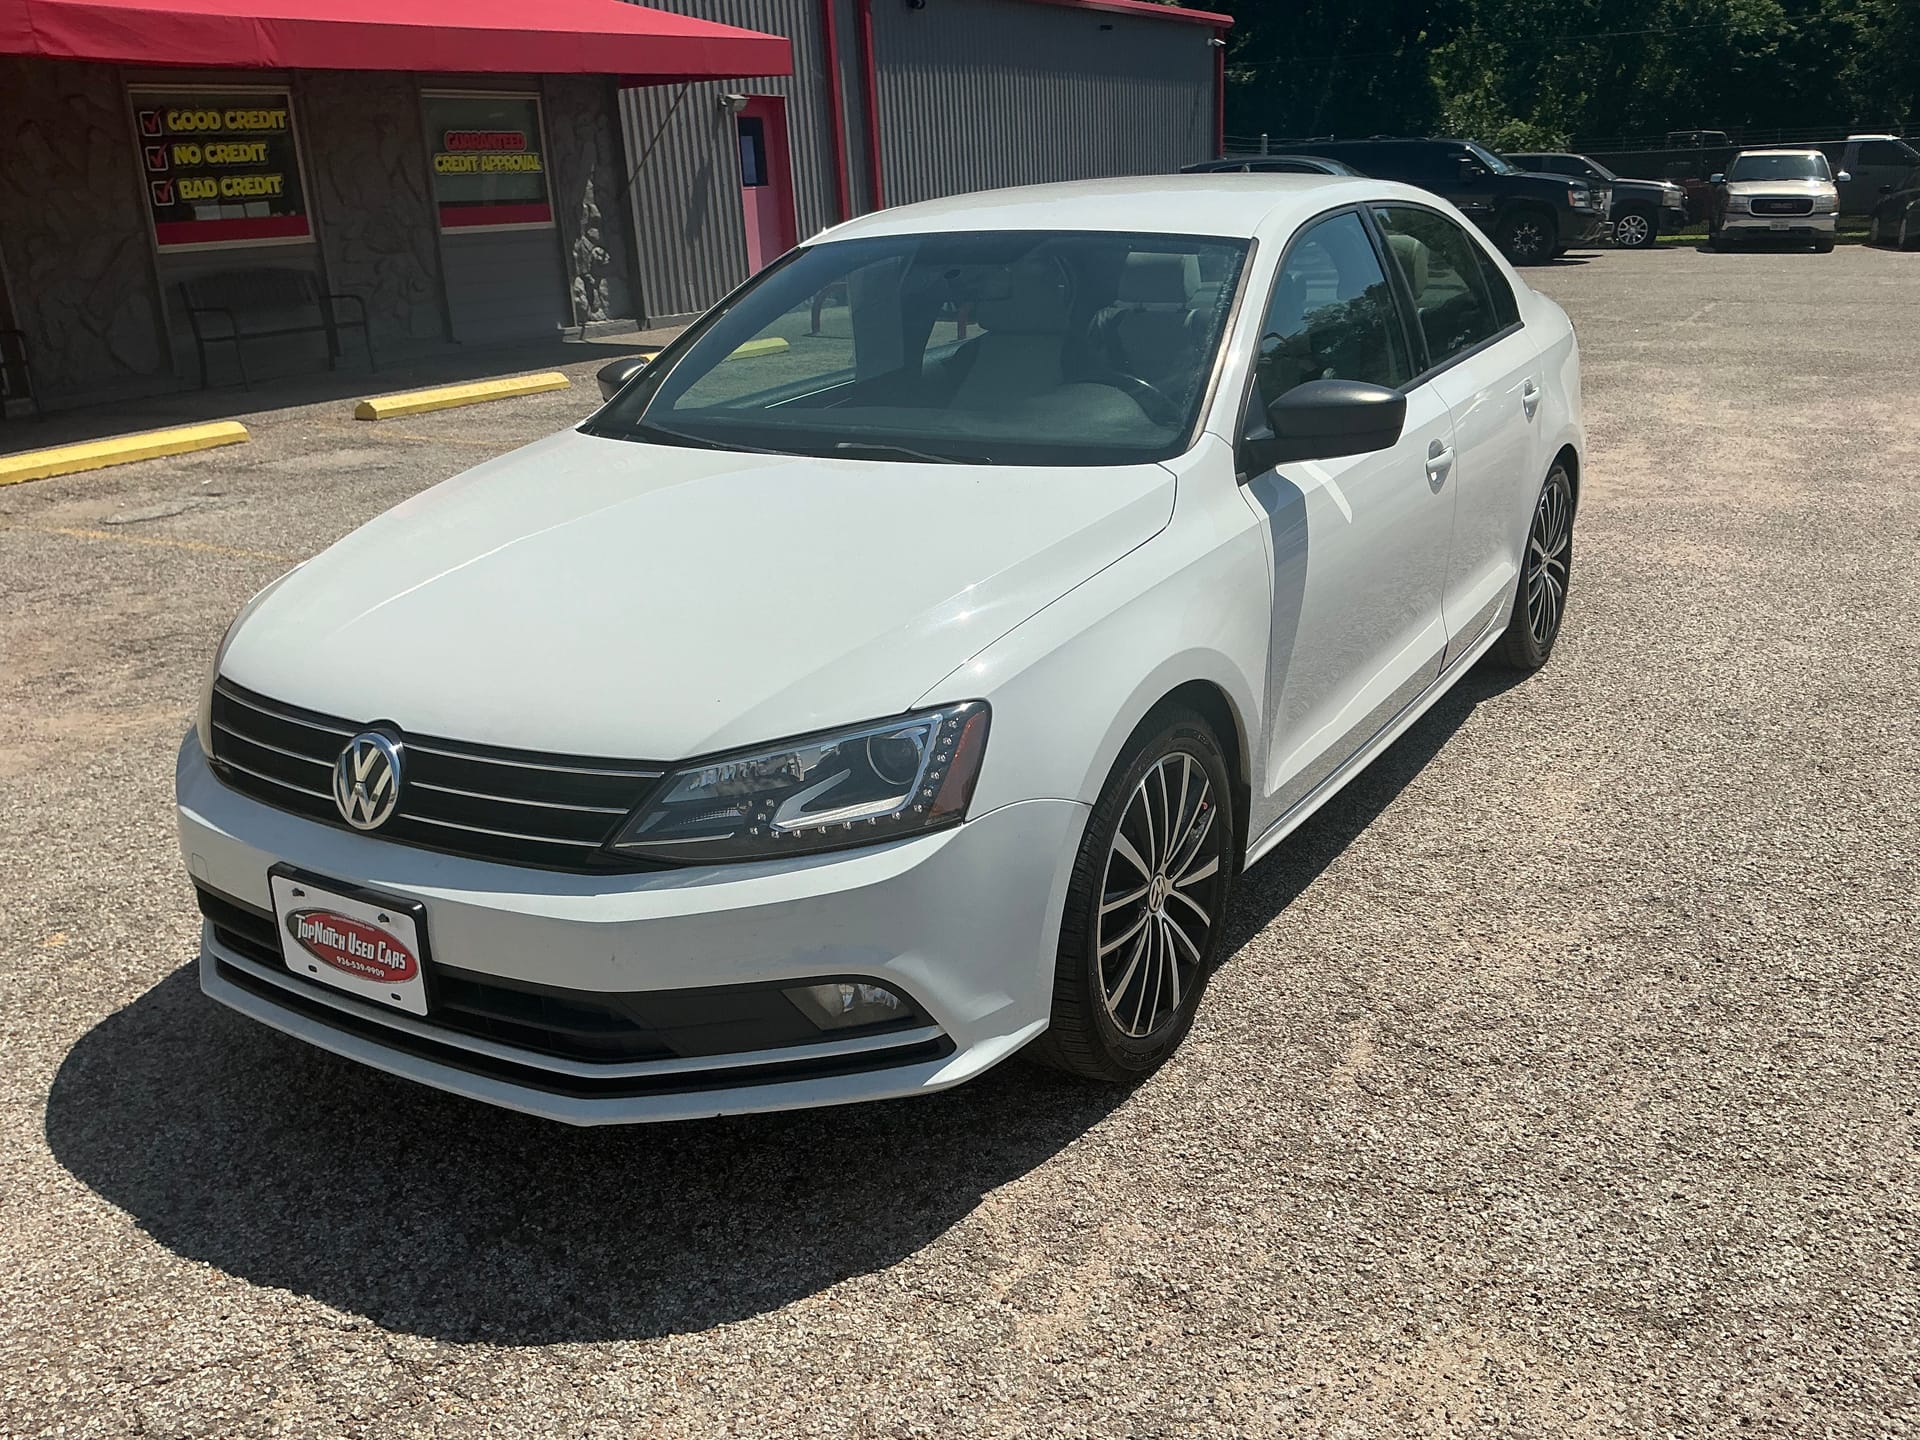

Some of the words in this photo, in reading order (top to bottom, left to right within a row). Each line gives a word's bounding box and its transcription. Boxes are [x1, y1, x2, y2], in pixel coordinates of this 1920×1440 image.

[167, 110, 221, 131] GOOD
[224, 110, 287, 130] CREDIT
[446, 132, 526, 151] GUARANTEED
[173, 145, 202, 165] NO
[204, 143, 267, 164] CREDIT
[434, 154, 479, 173] CREDIT
[480, 153, 543, 172] APPROVAL
[179, 179, 219, 199] BAD
[221, 175, 282, 197] CREDIT
